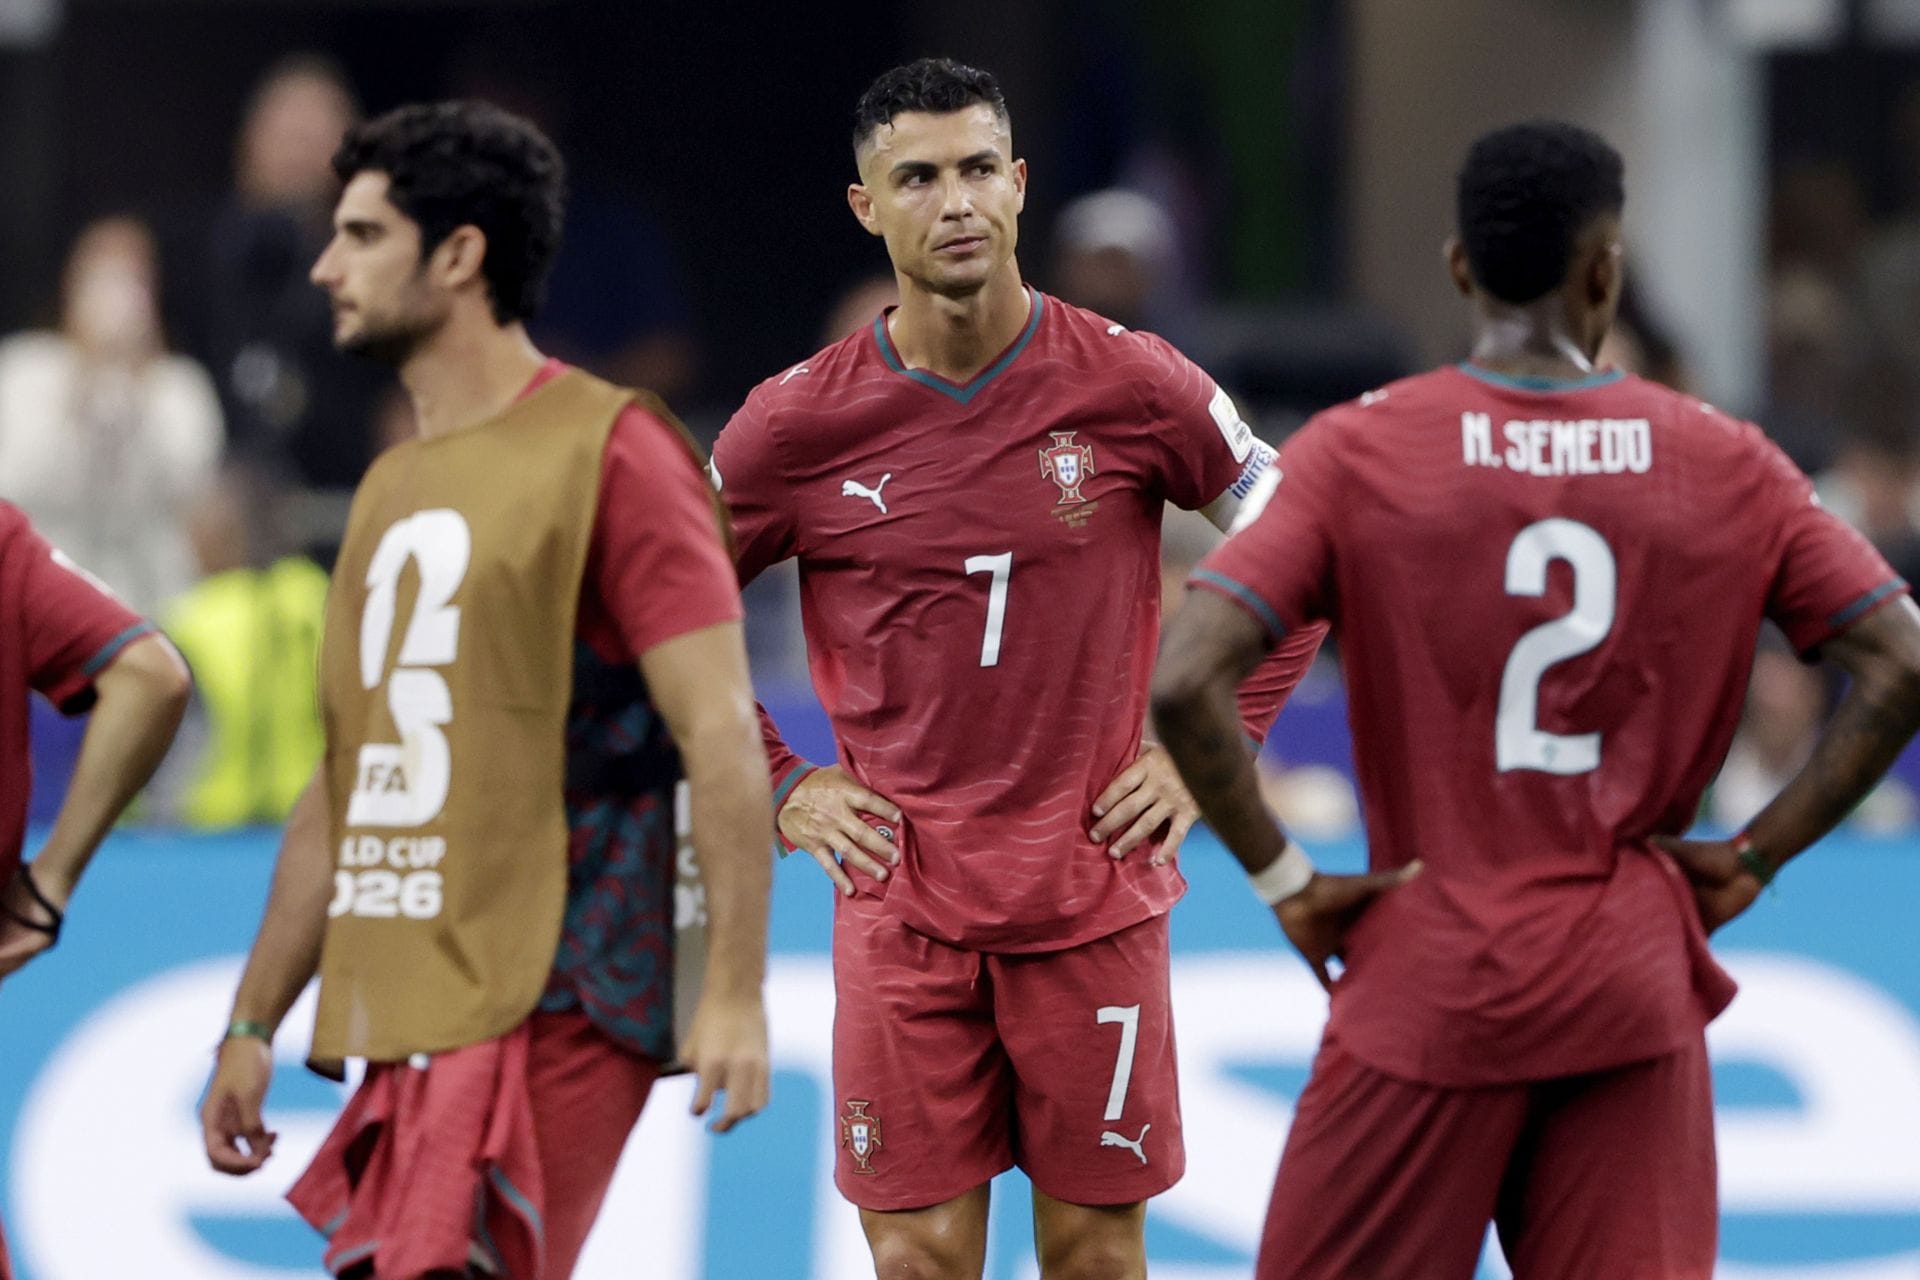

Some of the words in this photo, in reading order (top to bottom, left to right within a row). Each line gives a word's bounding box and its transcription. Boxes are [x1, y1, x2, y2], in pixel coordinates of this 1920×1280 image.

[964, 551, 1013, 668] 7
[1495, 516, 1617, 775] 2
[367, 763, 407, 792] FA
[386, 834, 447, 869] CUP
[1096, 1003, 1141, 1122] 7
